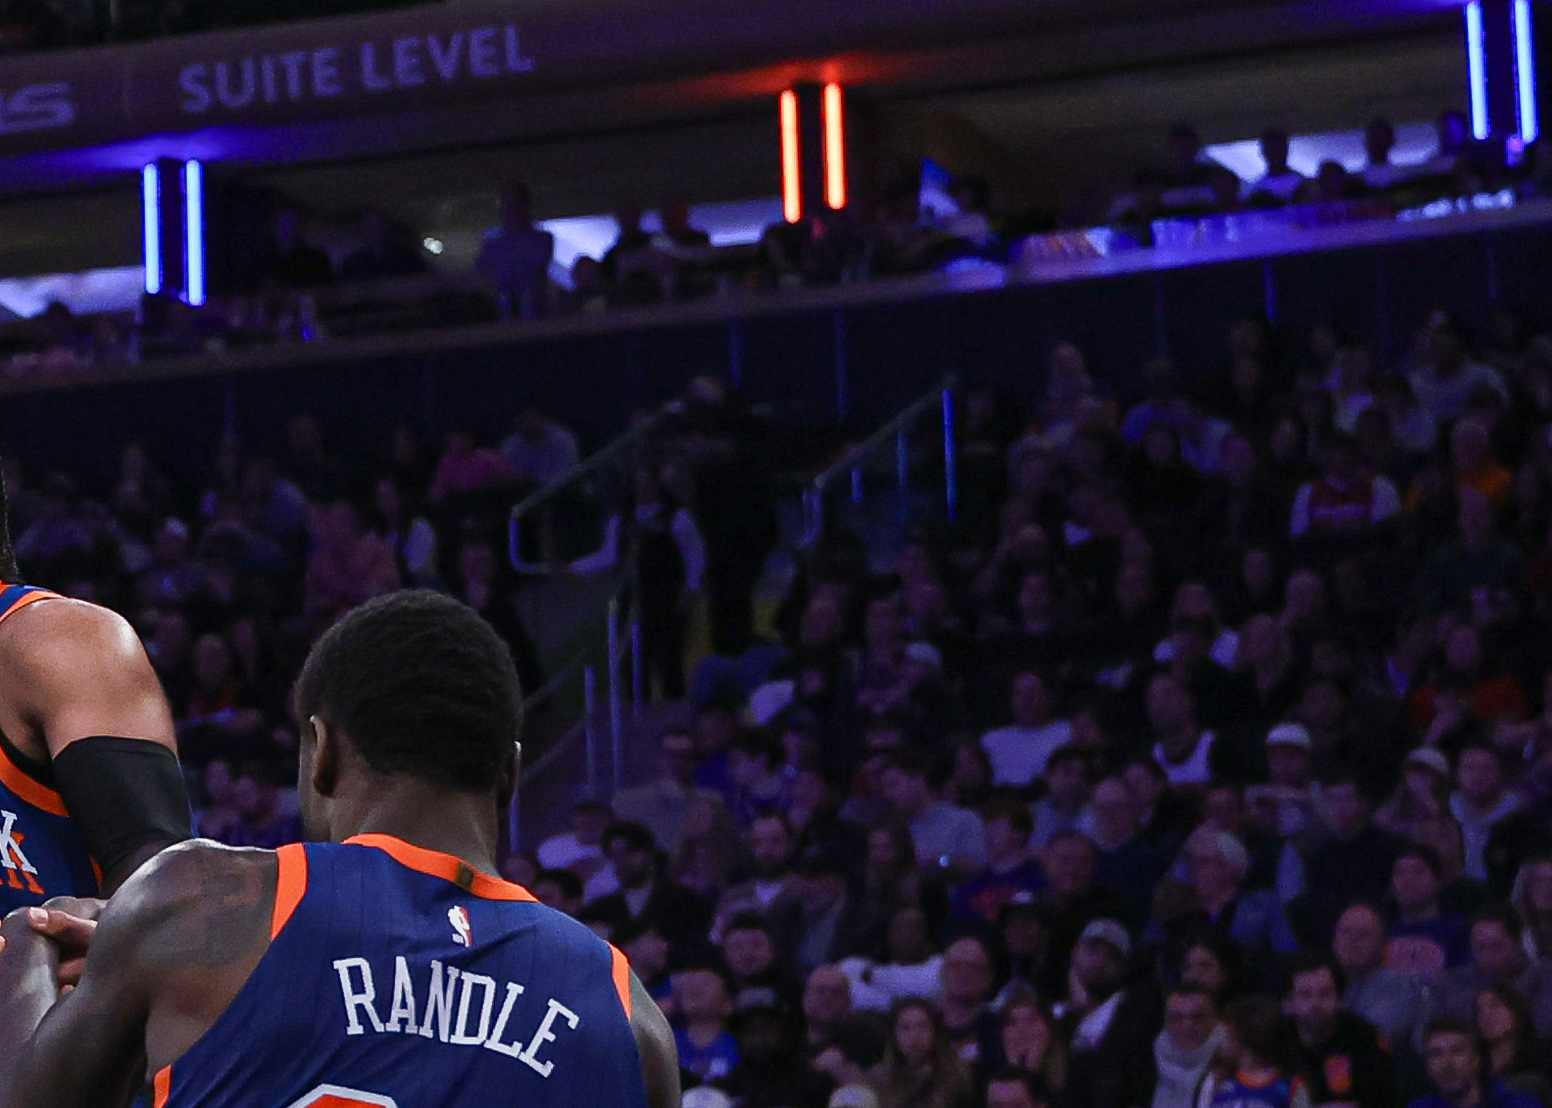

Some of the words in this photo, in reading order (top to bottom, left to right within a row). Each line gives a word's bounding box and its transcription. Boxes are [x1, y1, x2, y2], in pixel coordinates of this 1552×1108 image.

[178, 47, 345, 114] SUITE
[360, 24, 537, 92] LEVEL
[333, 955, 580, 1078] RANDLE
